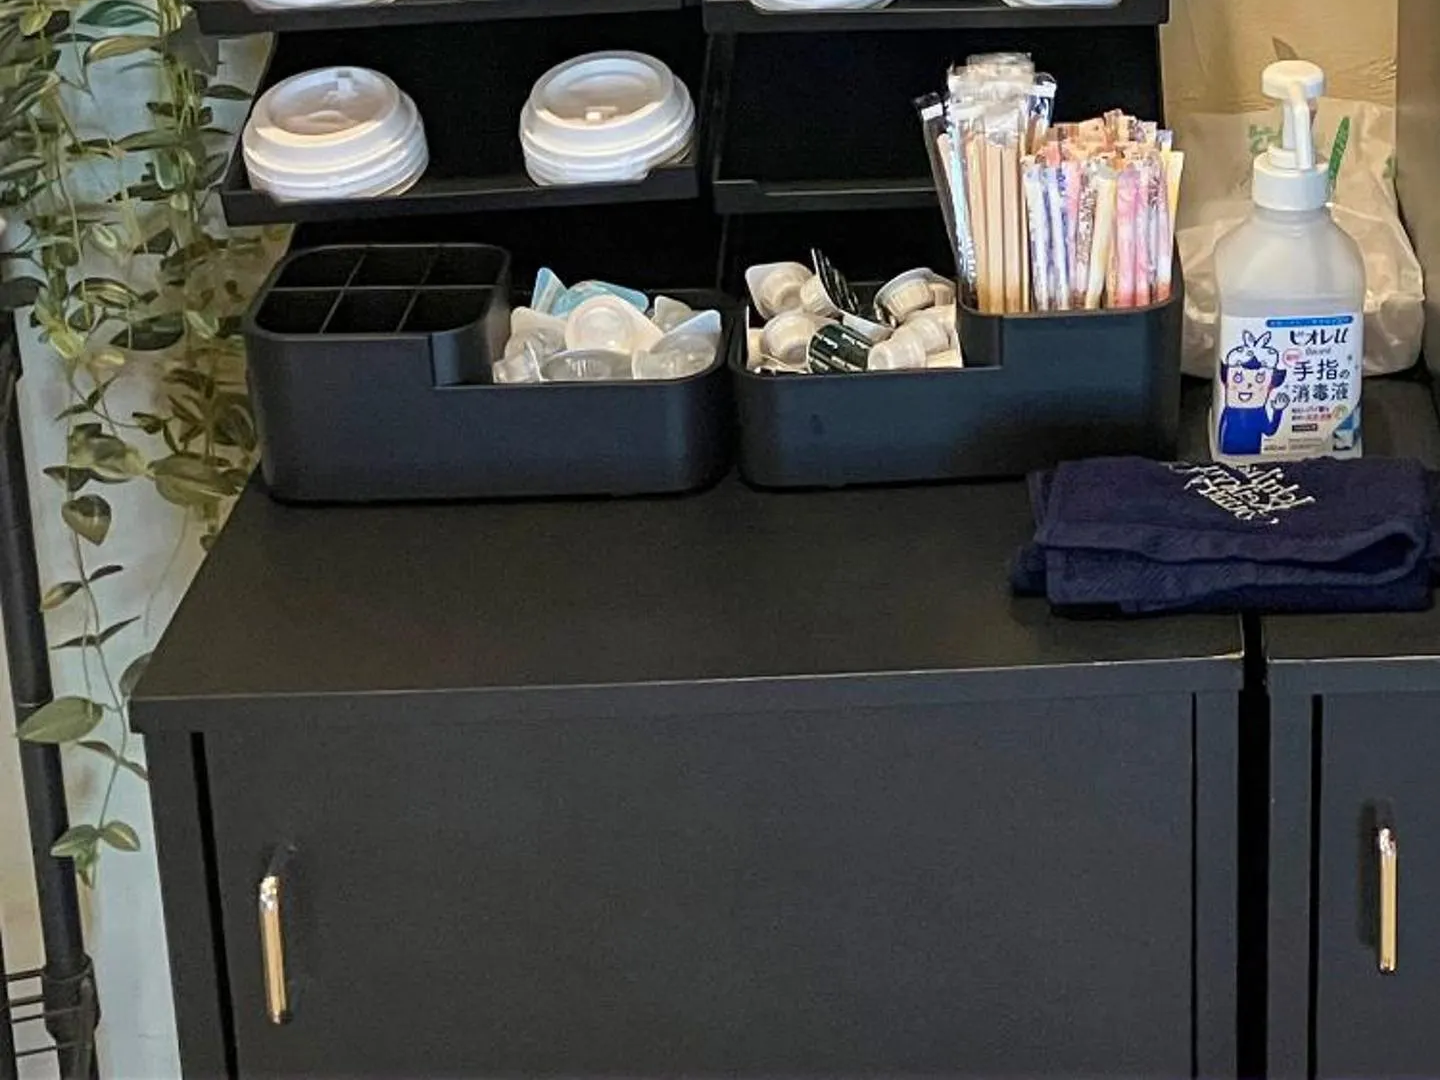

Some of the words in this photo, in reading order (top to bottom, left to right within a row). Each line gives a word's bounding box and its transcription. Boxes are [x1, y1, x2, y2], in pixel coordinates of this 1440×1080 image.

[1293, 358, 1350, 381] 手指の
[1291, 382, 1349, 403] 消毒液
